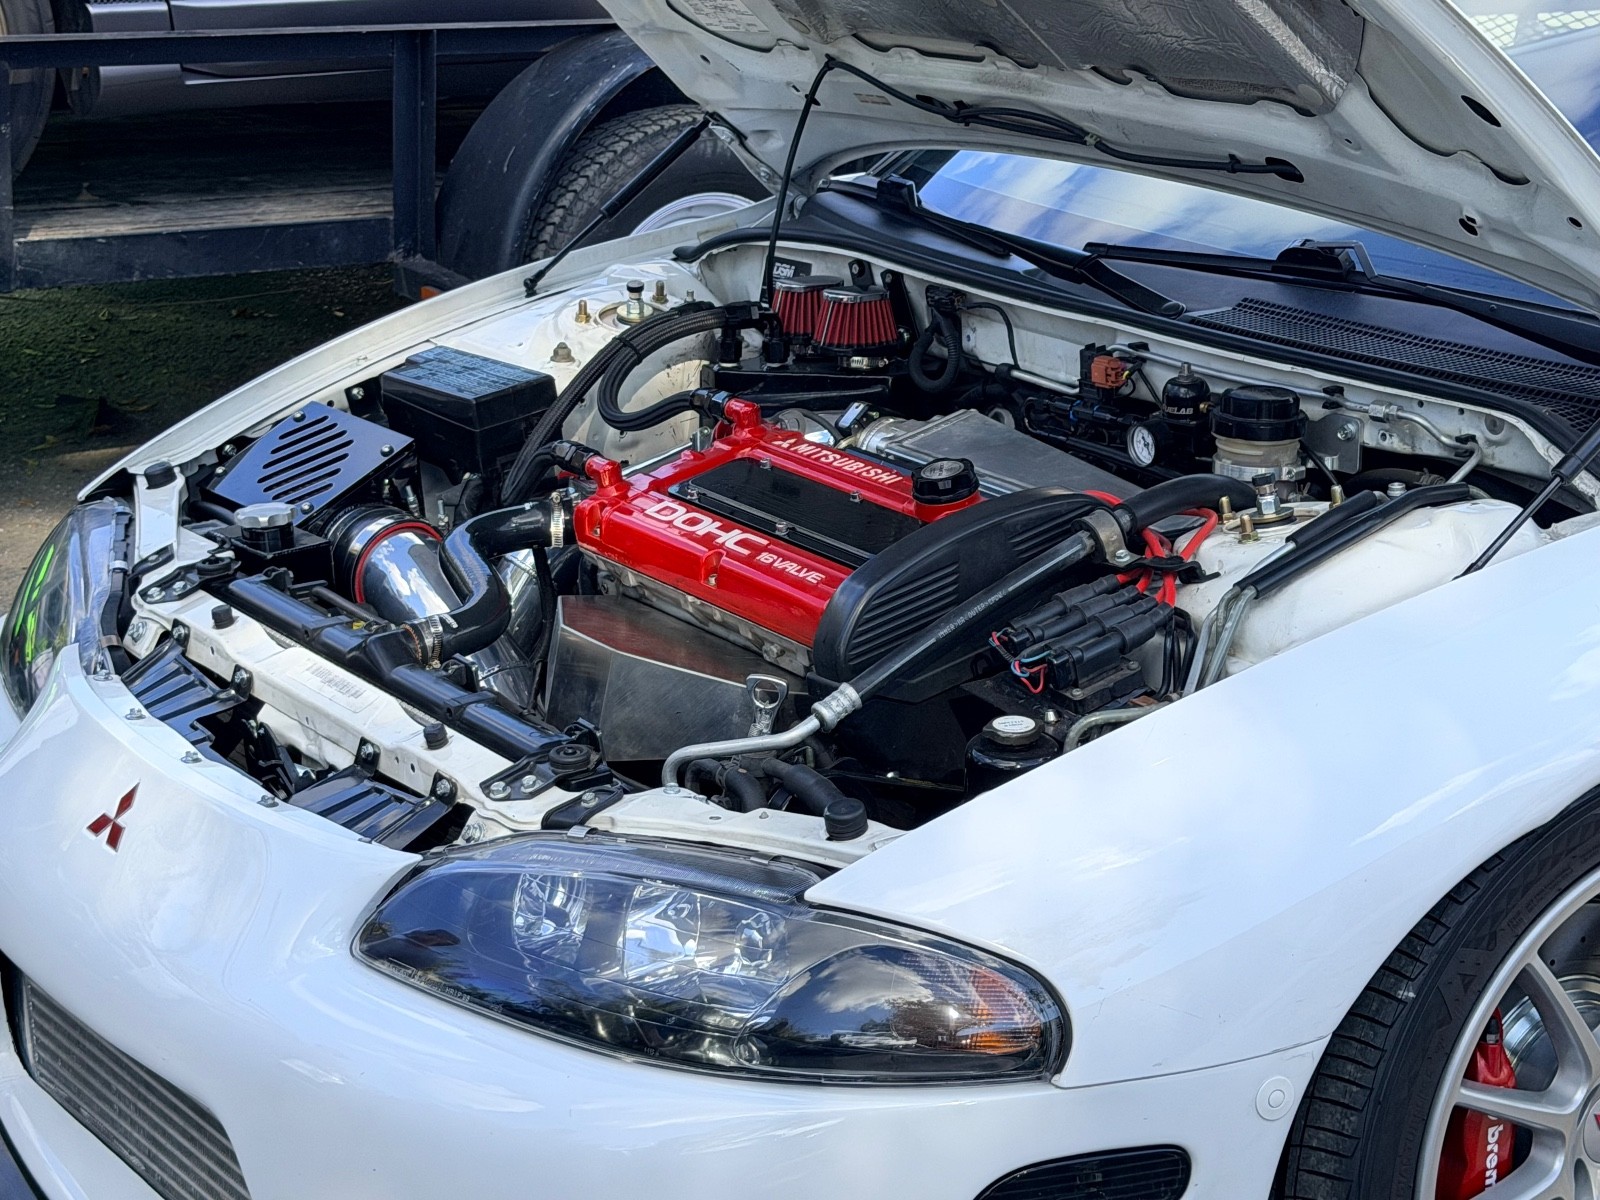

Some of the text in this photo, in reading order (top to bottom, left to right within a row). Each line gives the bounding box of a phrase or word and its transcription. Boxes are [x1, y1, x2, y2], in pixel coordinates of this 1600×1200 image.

[789, 443, 903, 485] MITSUBISHI
[644, 500, 770, 556] DOHC
[1484, 1123, 1504, 1191] brem
